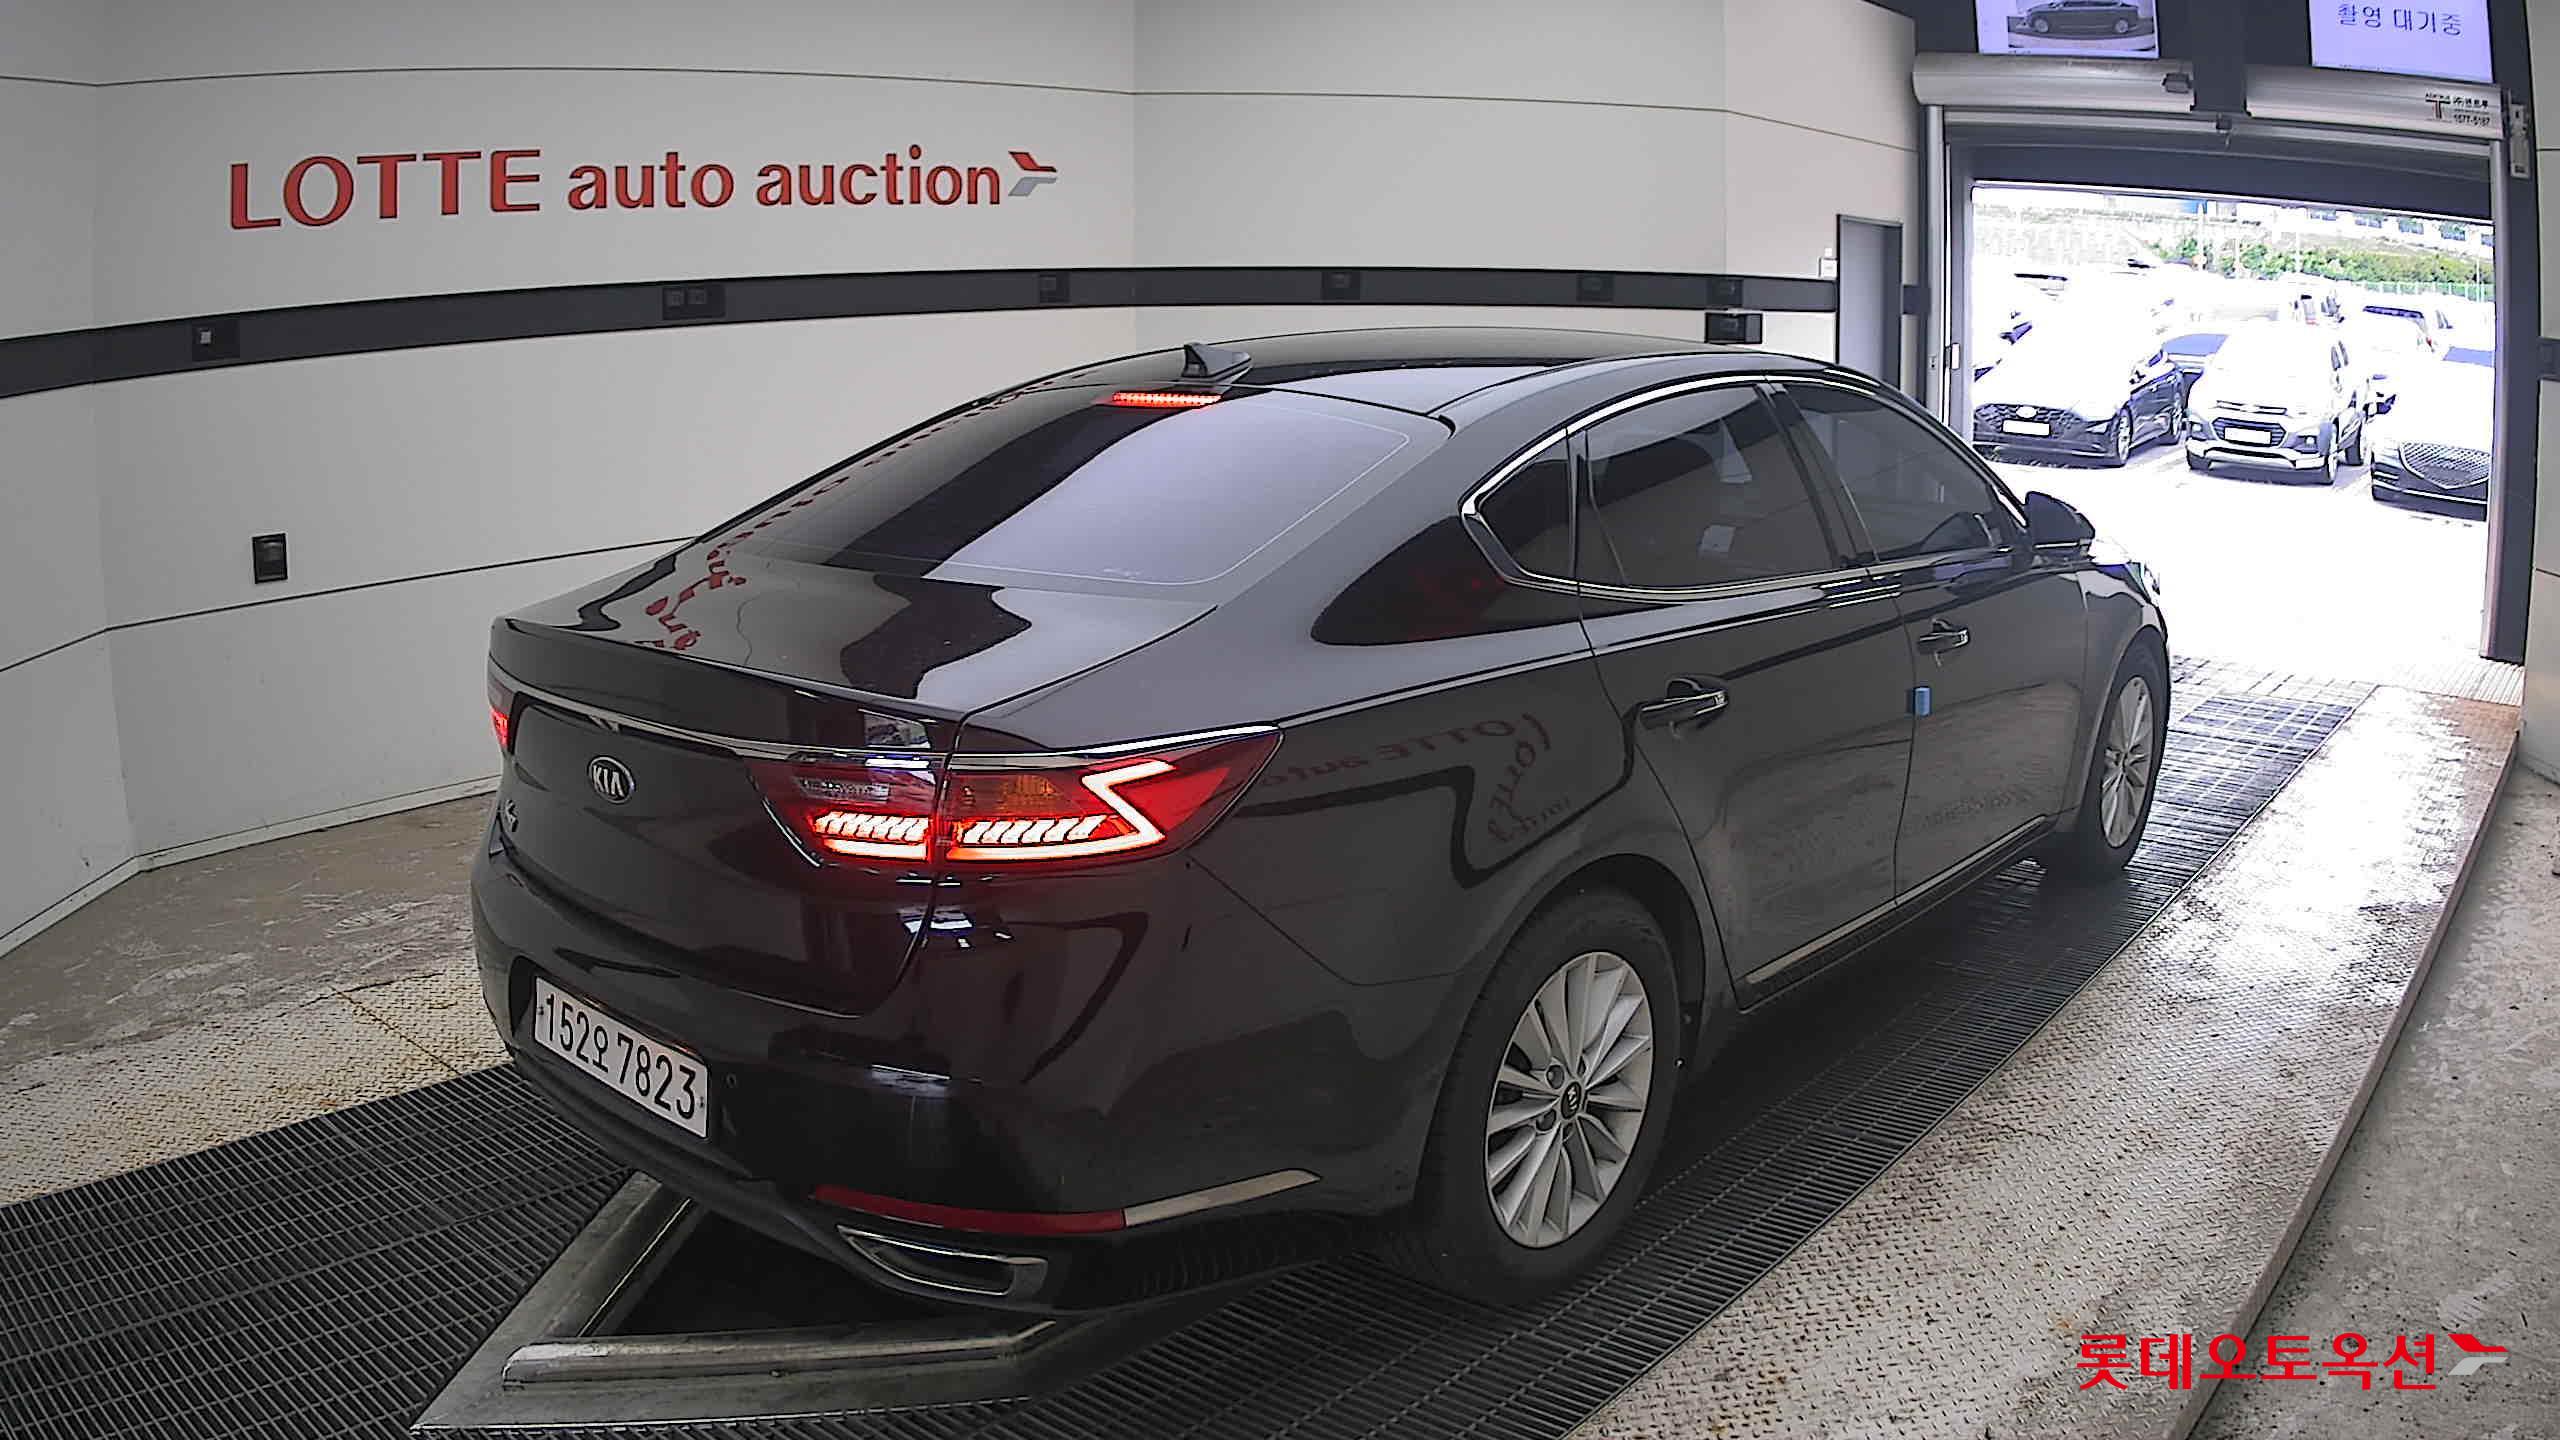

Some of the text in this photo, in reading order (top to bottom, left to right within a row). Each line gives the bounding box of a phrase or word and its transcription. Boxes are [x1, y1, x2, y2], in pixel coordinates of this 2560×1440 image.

[2338, 3, 2382, 28] 촬영
[230, 144, 1001, 230] LOTTE auto auction
[592, 764, 625, 797] KIA
[544, 992, 698, 1120] 152오 7823
